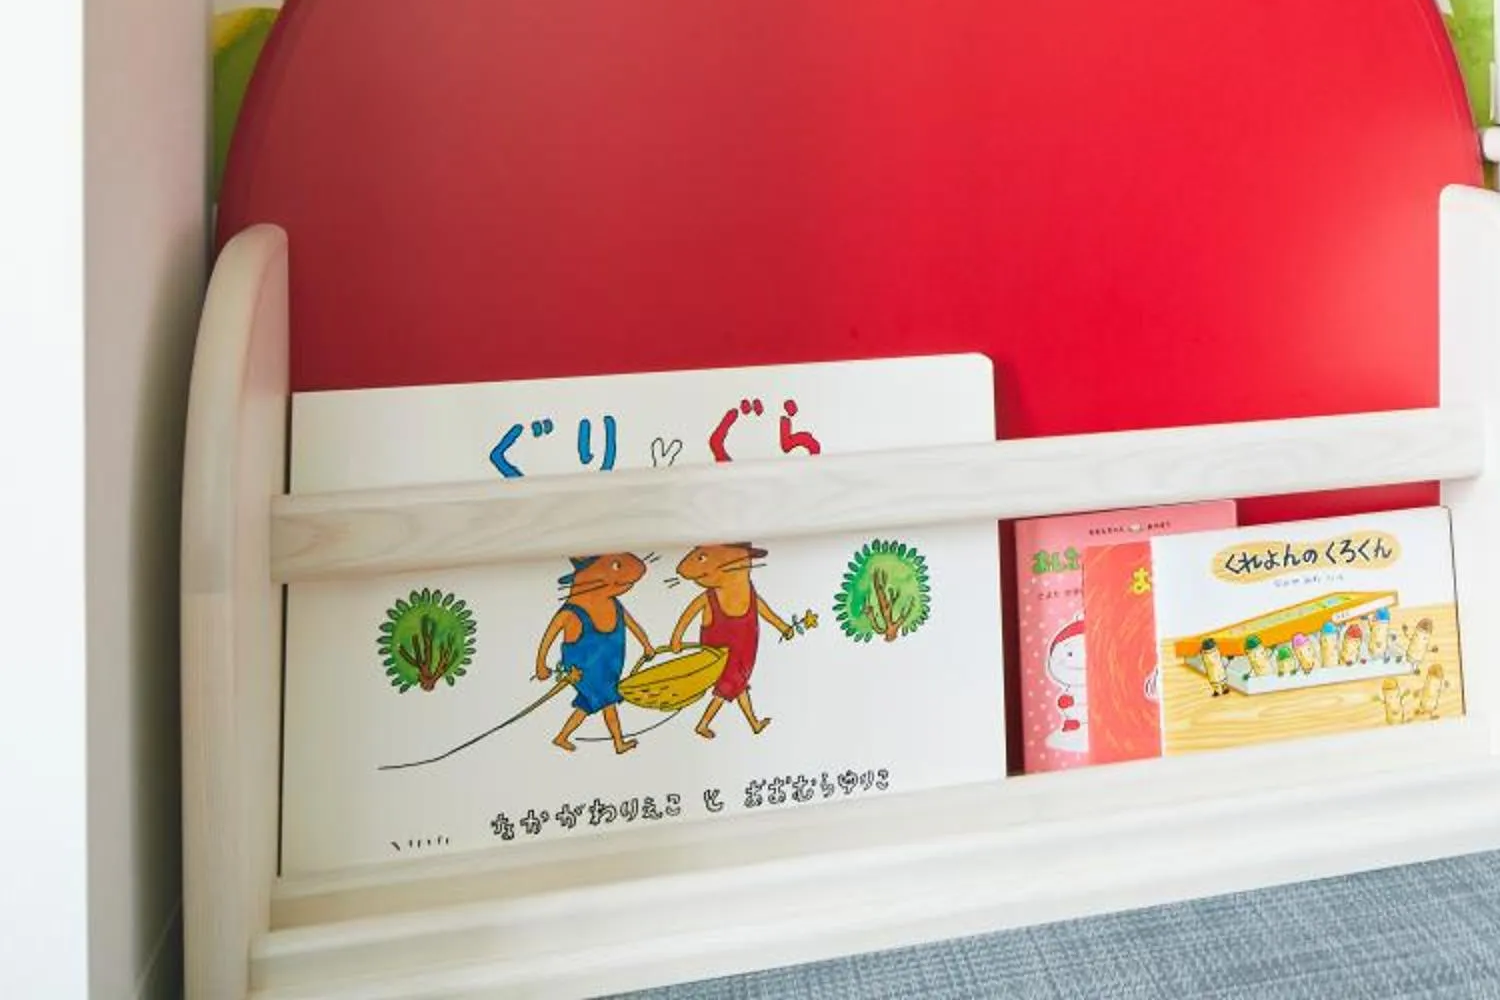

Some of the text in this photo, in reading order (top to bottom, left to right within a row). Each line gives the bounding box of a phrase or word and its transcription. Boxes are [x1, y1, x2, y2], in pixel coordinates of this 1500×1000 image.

[491, 793, 681, 840] なかがわりえこ
